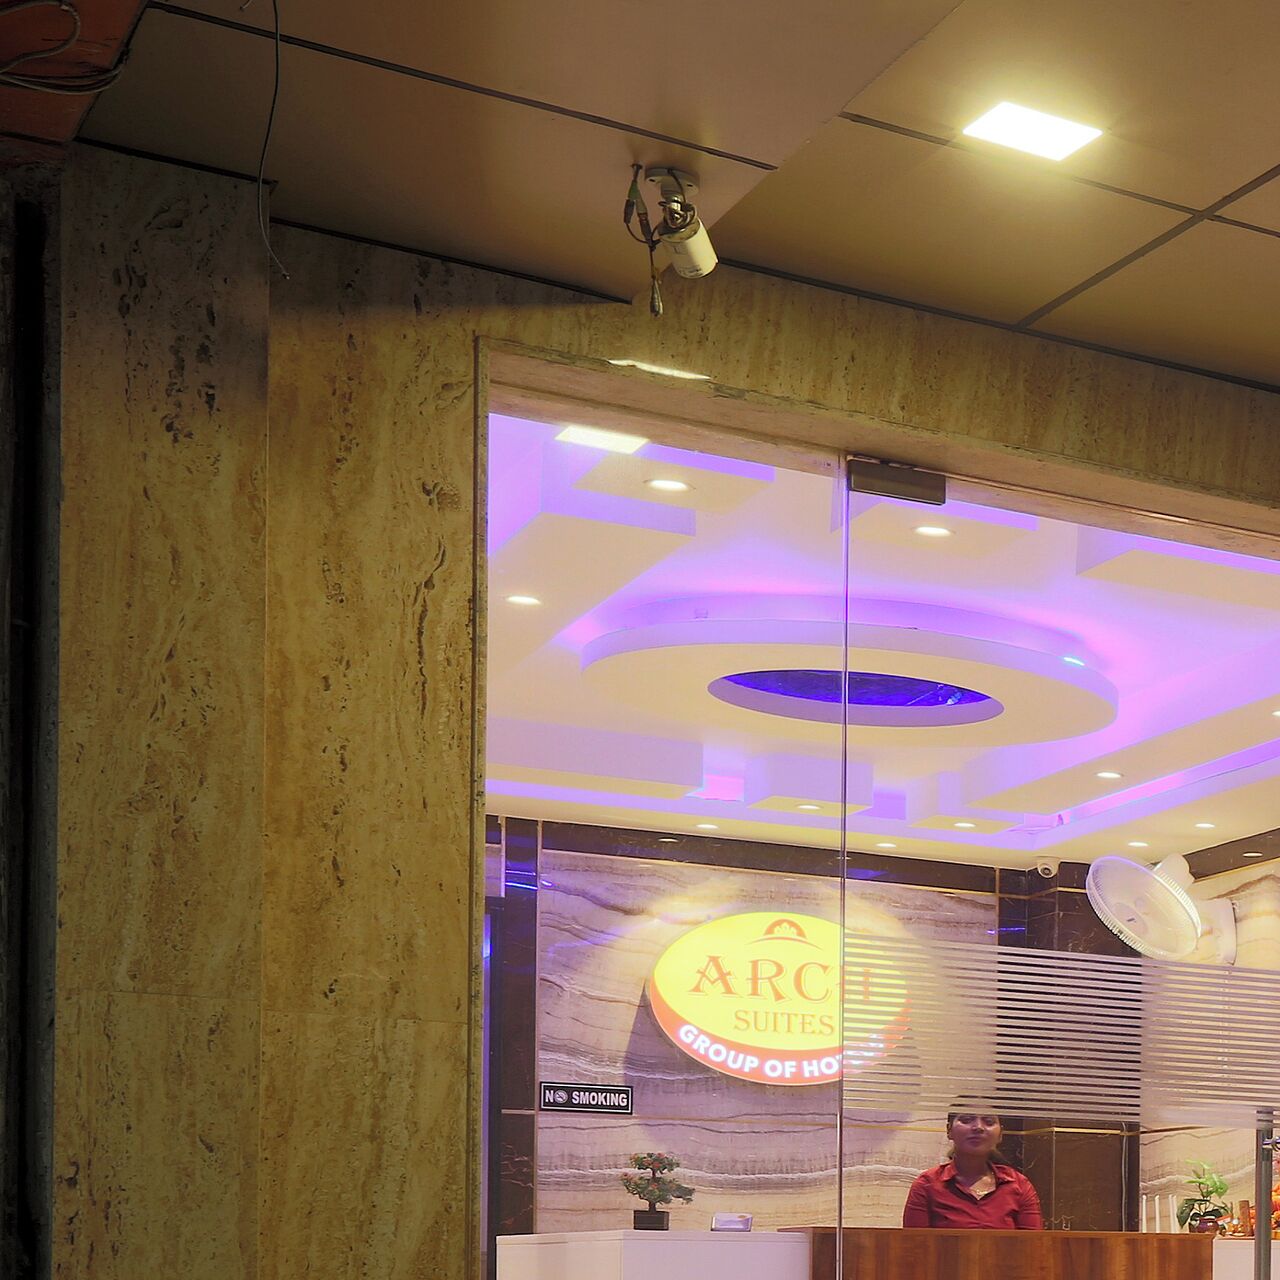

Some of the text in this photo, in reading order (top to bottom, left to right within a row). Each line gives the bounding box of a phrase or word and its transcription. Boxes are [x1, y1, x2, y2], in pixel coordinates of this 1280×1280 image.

[734, 1008, 835, 1036] SUITES
[679, 1024, 760, 1073] GROUP
[763, 1058, 797, 1079] OF
[571, 1091, 628, 1107] SMOKING
